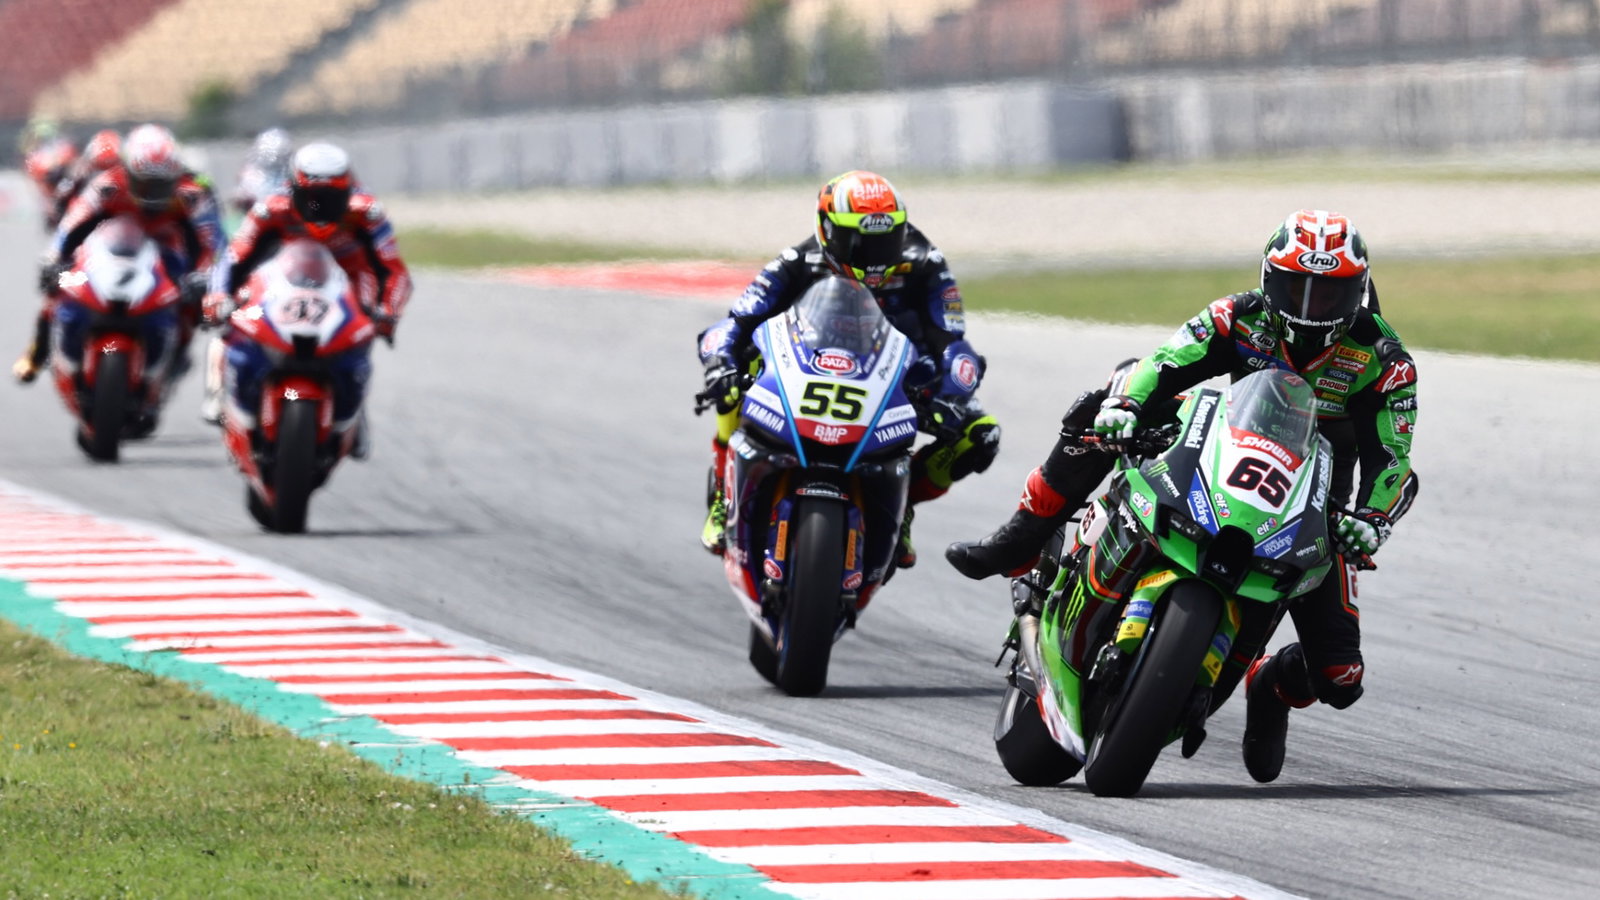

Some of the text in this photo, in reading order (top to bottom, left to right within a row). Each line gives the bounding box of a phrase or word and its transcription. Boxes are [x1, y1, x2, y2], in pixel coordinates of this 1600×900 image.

[1305, 254, 1334, 267] Arai
[1279, 309, 1344, 327] www.jonathan-rea.com
[820, 357, 849, 369] PATA
[1247, 356, 1268, 369] elf
[1318, 379, 1348, 391] SHOWA
[799, 382, 867, 422] 55
[1394, 398, 1413, 410] elf
[746, 402, 786, 432] YAMAHA
[1184, 395, 1218, 449] Kawasaki
[814, 425, 848, 438] BMP
[874, 421, 915, 443] YAMAHA
[1240, 436, 1293, 466] SHOWA
[1226, 456, 1292, 508] 65
[1311, 448, 1329, 512] Kawasaki
[1132, 492, 1147, 509] elf
[1214, 493, 1228, 508] elf
[1257, 521, 1270, 535] elf
